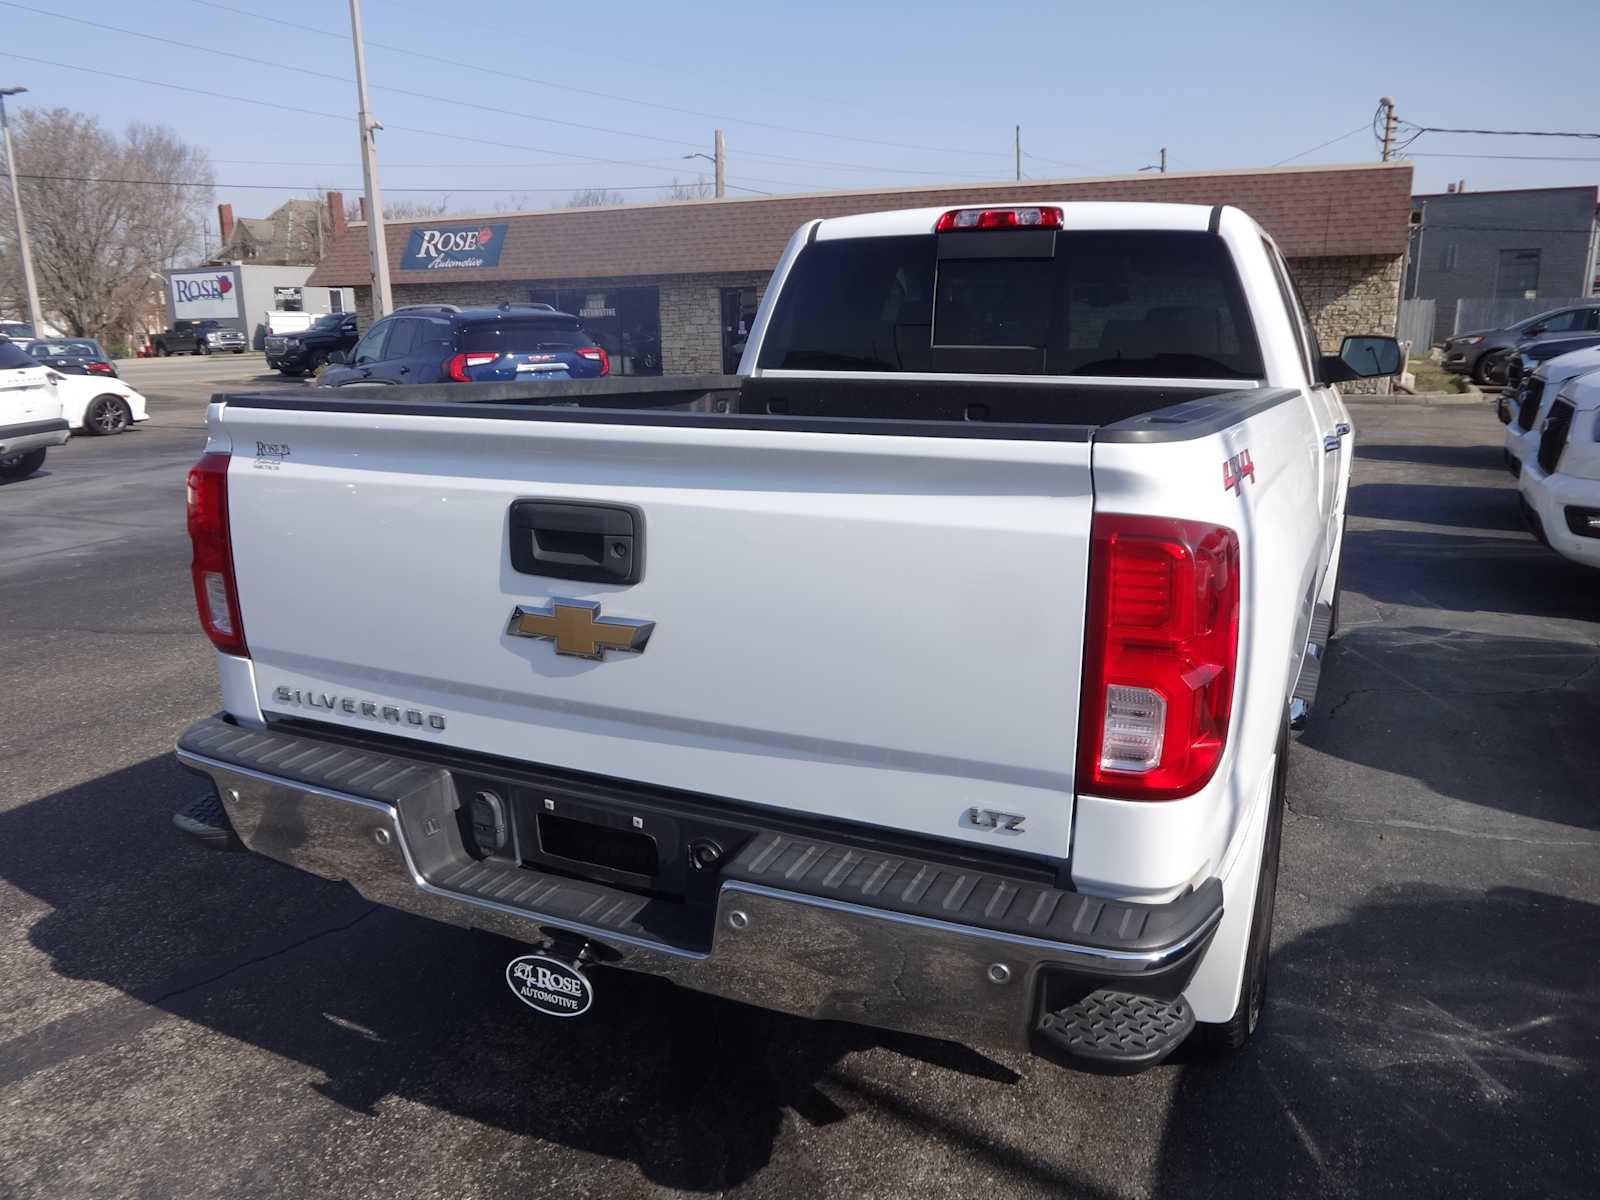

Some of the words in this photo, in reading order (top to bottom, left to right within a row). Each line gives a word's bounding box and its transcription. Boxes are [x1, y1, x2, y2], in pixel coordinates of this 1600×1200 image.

[416, 230, 478, 257] ROSE
[428, 253, 482, 269] Automotive
[174, 280, 218, 302] ROSE
[276, 685, 447, 730] SILVERADO
[966, 806, 1026, 834] LTZ
[535, 966, 582, 996] ROSE
[520, 986, 579, 1010] AUTOMOTIVE
